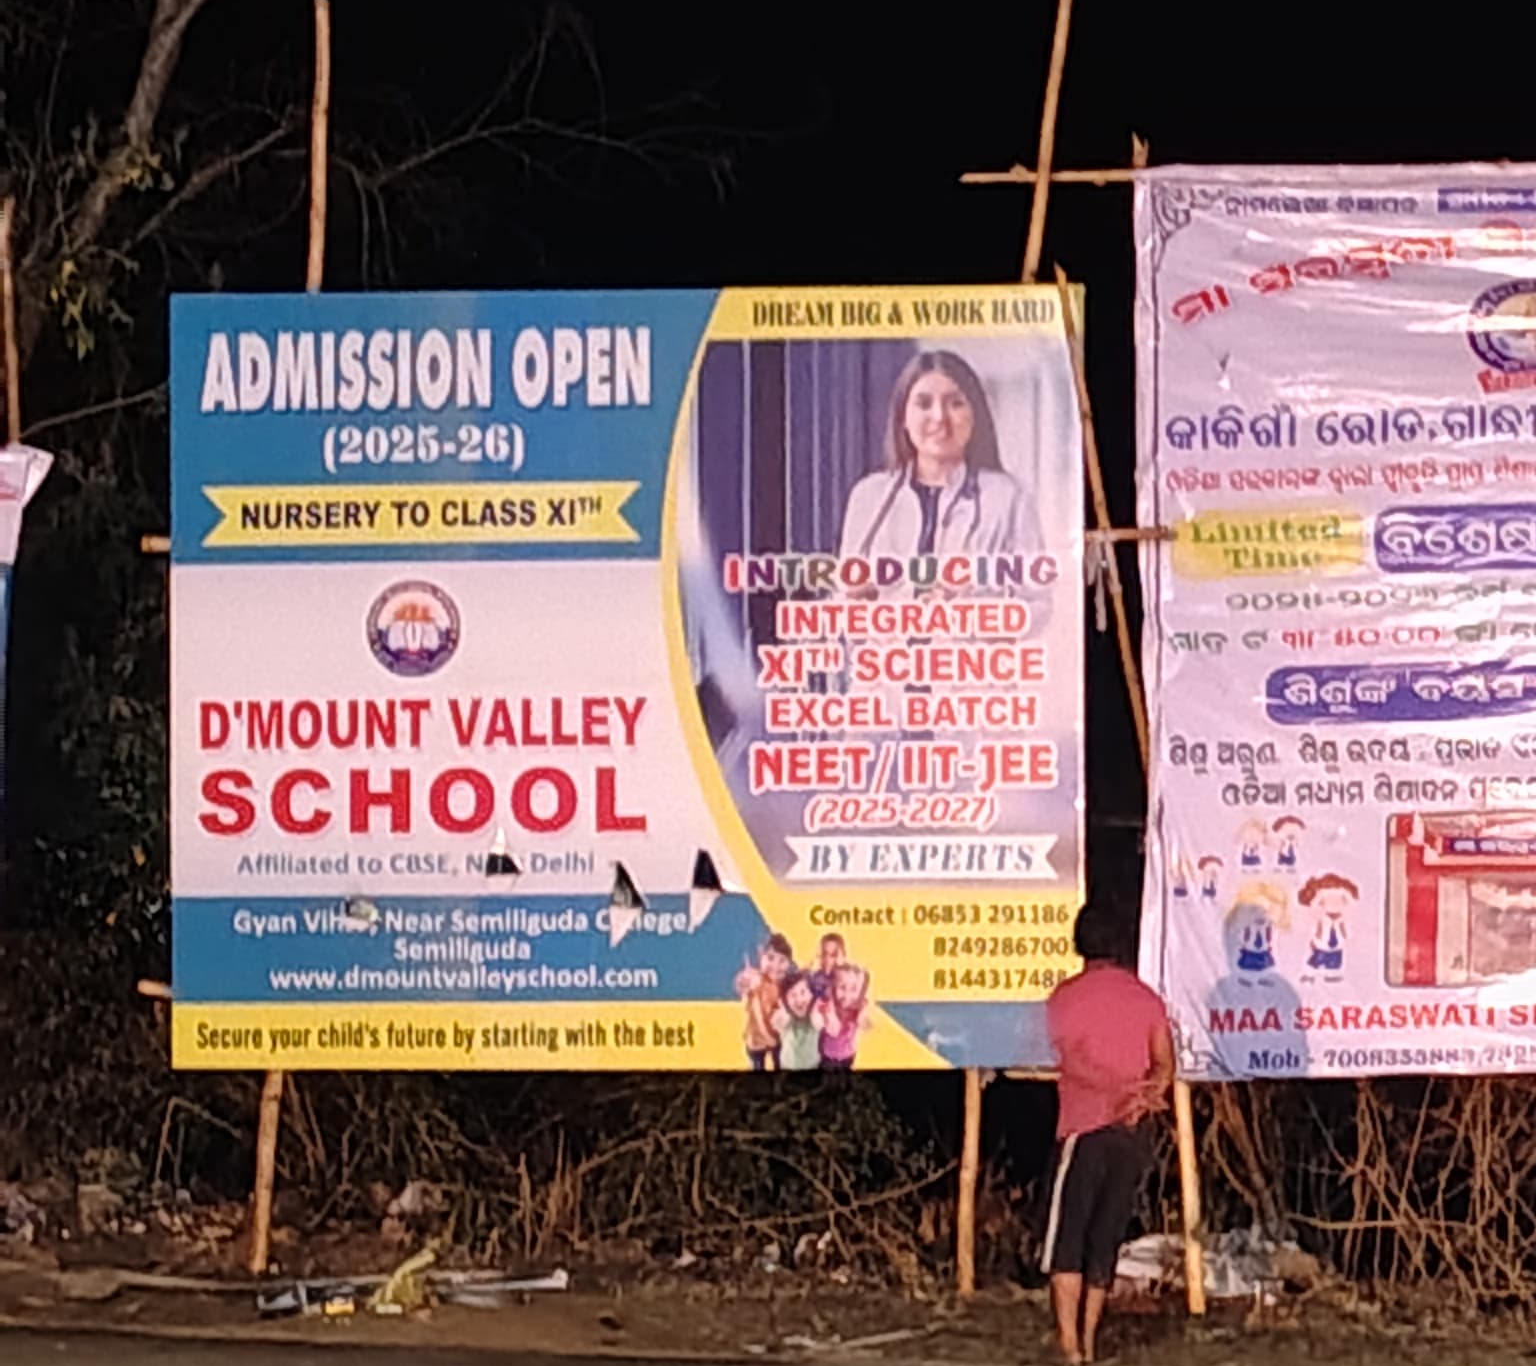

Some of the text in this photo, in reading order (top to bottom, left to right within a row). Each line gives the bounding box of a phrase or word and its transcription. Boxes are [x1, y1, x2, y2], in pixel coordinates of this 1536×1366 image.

[752, 299, 1056, 327] DREAM BIG & WORK HARD
[200, 325, 651, 413] ADMISSION OPEN
[322, 422, 526, 474] (2025-26)
[240, 501, 381, 530] NURSERY
[391, 501, 430, 526] TO
[441, 499, 536, 525] CLASS
[1190, 515, 1342, 544] Limited
[726, 555, 1059, 589] INTRODUCING
[779, 603, 1028, 634] INTEGRATED
[855, 647, 1045, 682] SCIENCE
[199, 696, 648, 750] D'MOUNT VALLEY
[769, 695, 1037, 727] EXCEL BATCH
[902, 744, 1055, 790] IIT-JEE
[199, 766, 648, 835] SCHOOL
[808, 796, 996, 829] (2025-2027)
[237, 852, 350, 875] Affiliated
[358, 854, 383, 875] to
[389, 853, 458, 876] CBSE,
[530, 852, 594, 873] Delhi
[808, 843, 1035, 873] BY EXPERTS
[233, 908, 298, 938] Gyan
[385, 909, 445, 934] Near
[451, 907, 588, 935] Semiliguda
[808, 903, 895, 925] Contact
[988, 903, 1070, 925] 291186
[393, 937, 532, 964] Semiliguda
[933, 936, 1070, 957] 8249286700
[269, 963, 659, 995] www.dmountvalleyschool.com
[1209, 1007, 1284, 1034] MAA
[1294, 1003, 1495, 1032] SARASWATI
[196, 1020, 695, 1053] Secure your child's future by starting with the best
[1247, 1049, 1300, 1070] Mob
